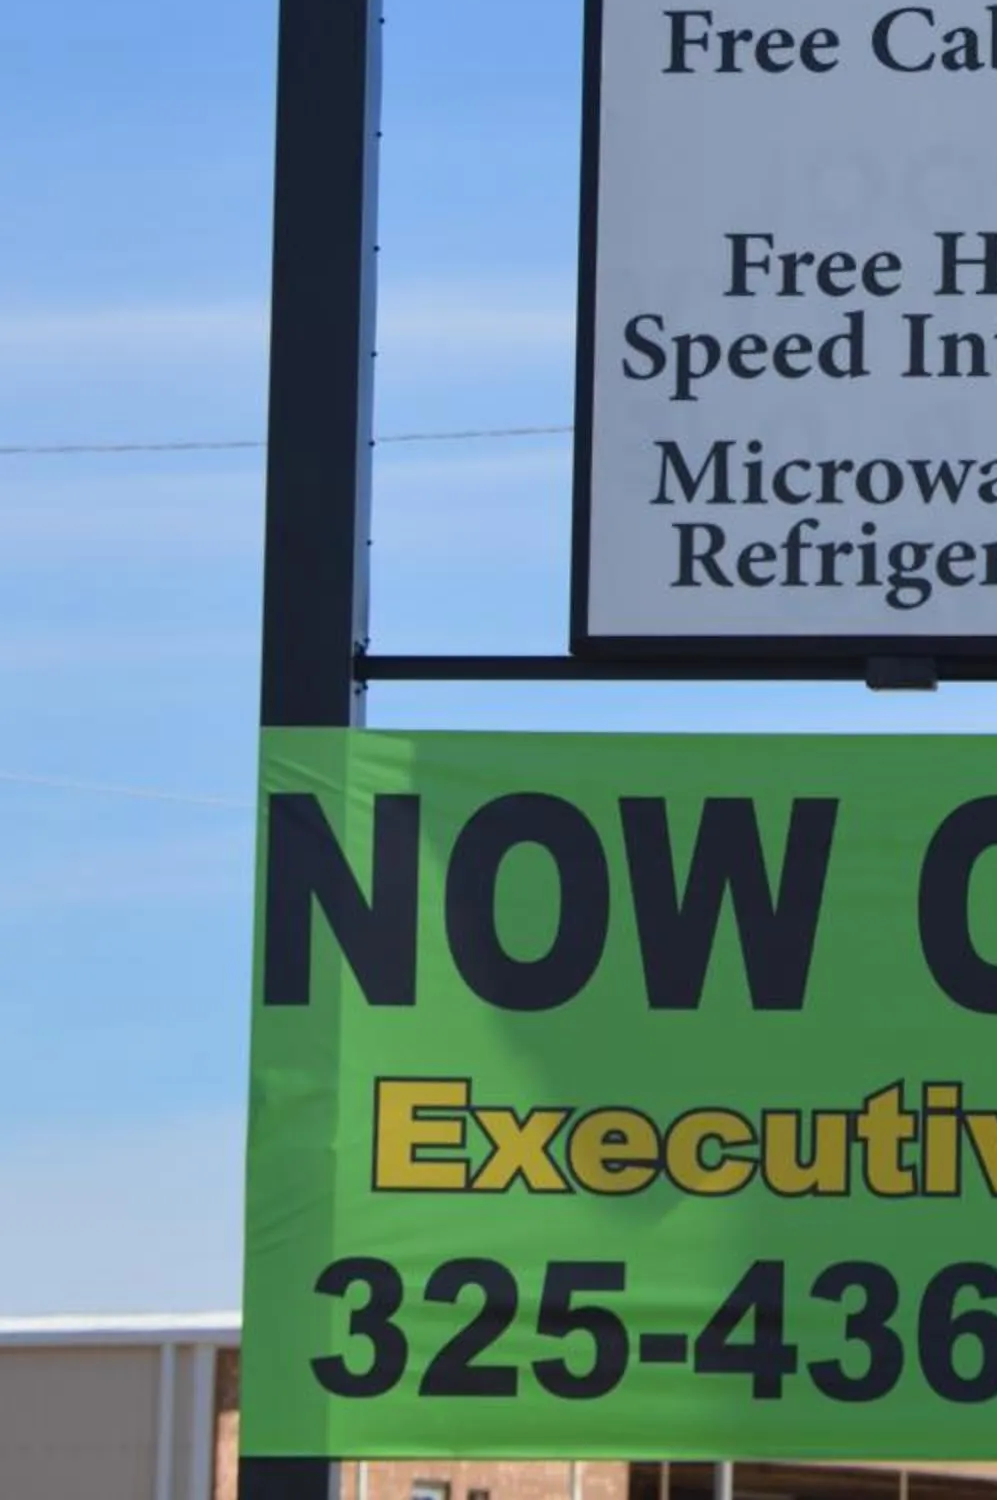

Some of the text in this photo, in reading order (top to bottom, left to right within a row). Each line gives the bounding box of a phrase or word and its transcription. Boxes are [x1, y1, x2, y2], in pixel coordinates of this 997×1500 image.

[661, 9, 841, 75] Free
[722, 231, 903, 299] Free
[621, 308, 871, 403] Speed
[261, 790, 841, 1014] NOW
